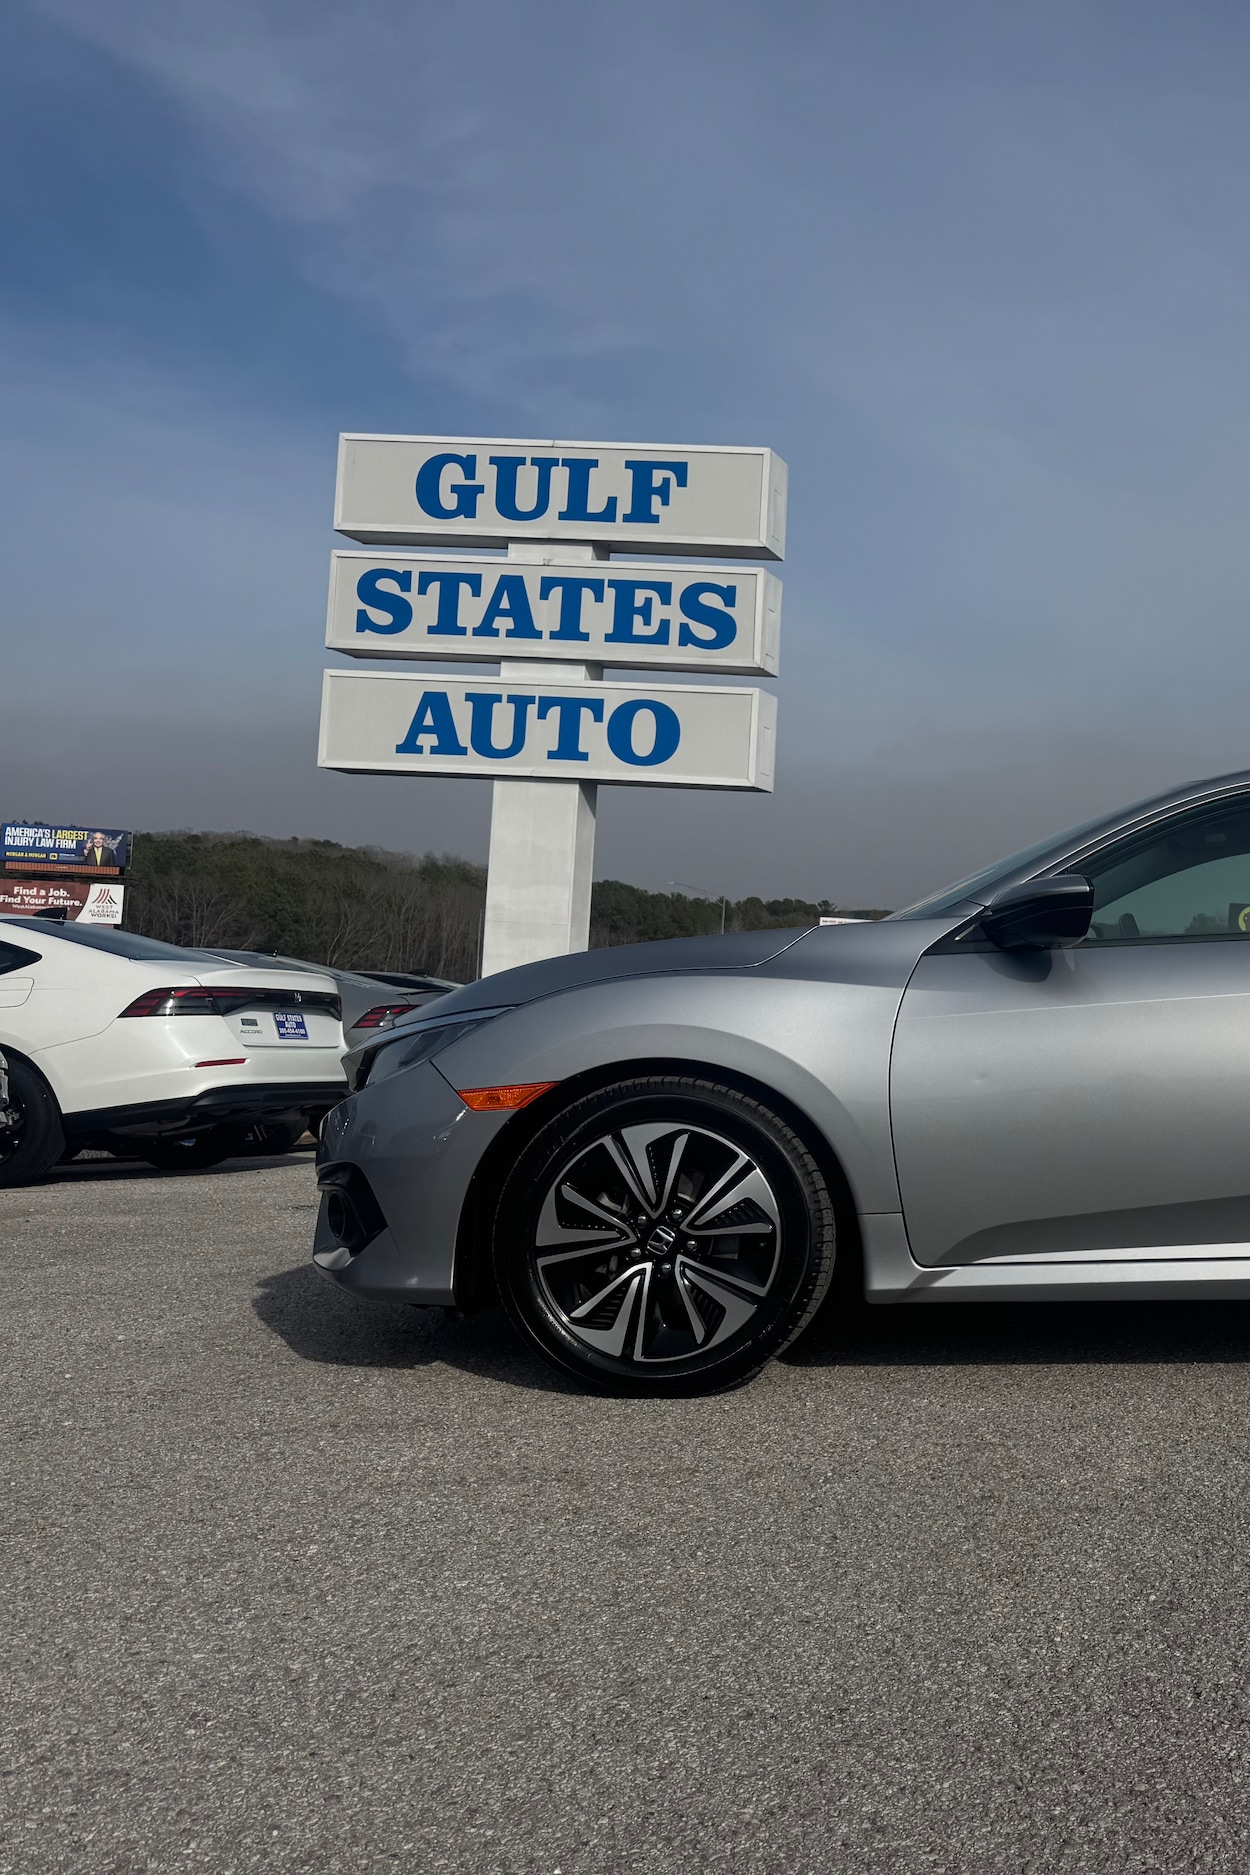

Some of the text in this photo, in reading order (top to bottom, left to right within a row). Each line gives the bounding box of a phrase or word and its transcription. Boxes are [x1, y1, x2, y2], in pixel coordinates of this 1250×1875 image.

[415, 453, 688, 524] GULF
[355, 567, 738, 650] STATES
[395, 691, 681, 767] AUTO
[5, 827, 89, 841] AMERICA'S LARGEST
[5, 837, 76, 849] INJURY LAW FIRM
[14, 886, 37, 895] Find
[48, 888, 70, 897] Job.
[0, 895, 83, 907] Find Your Future.
